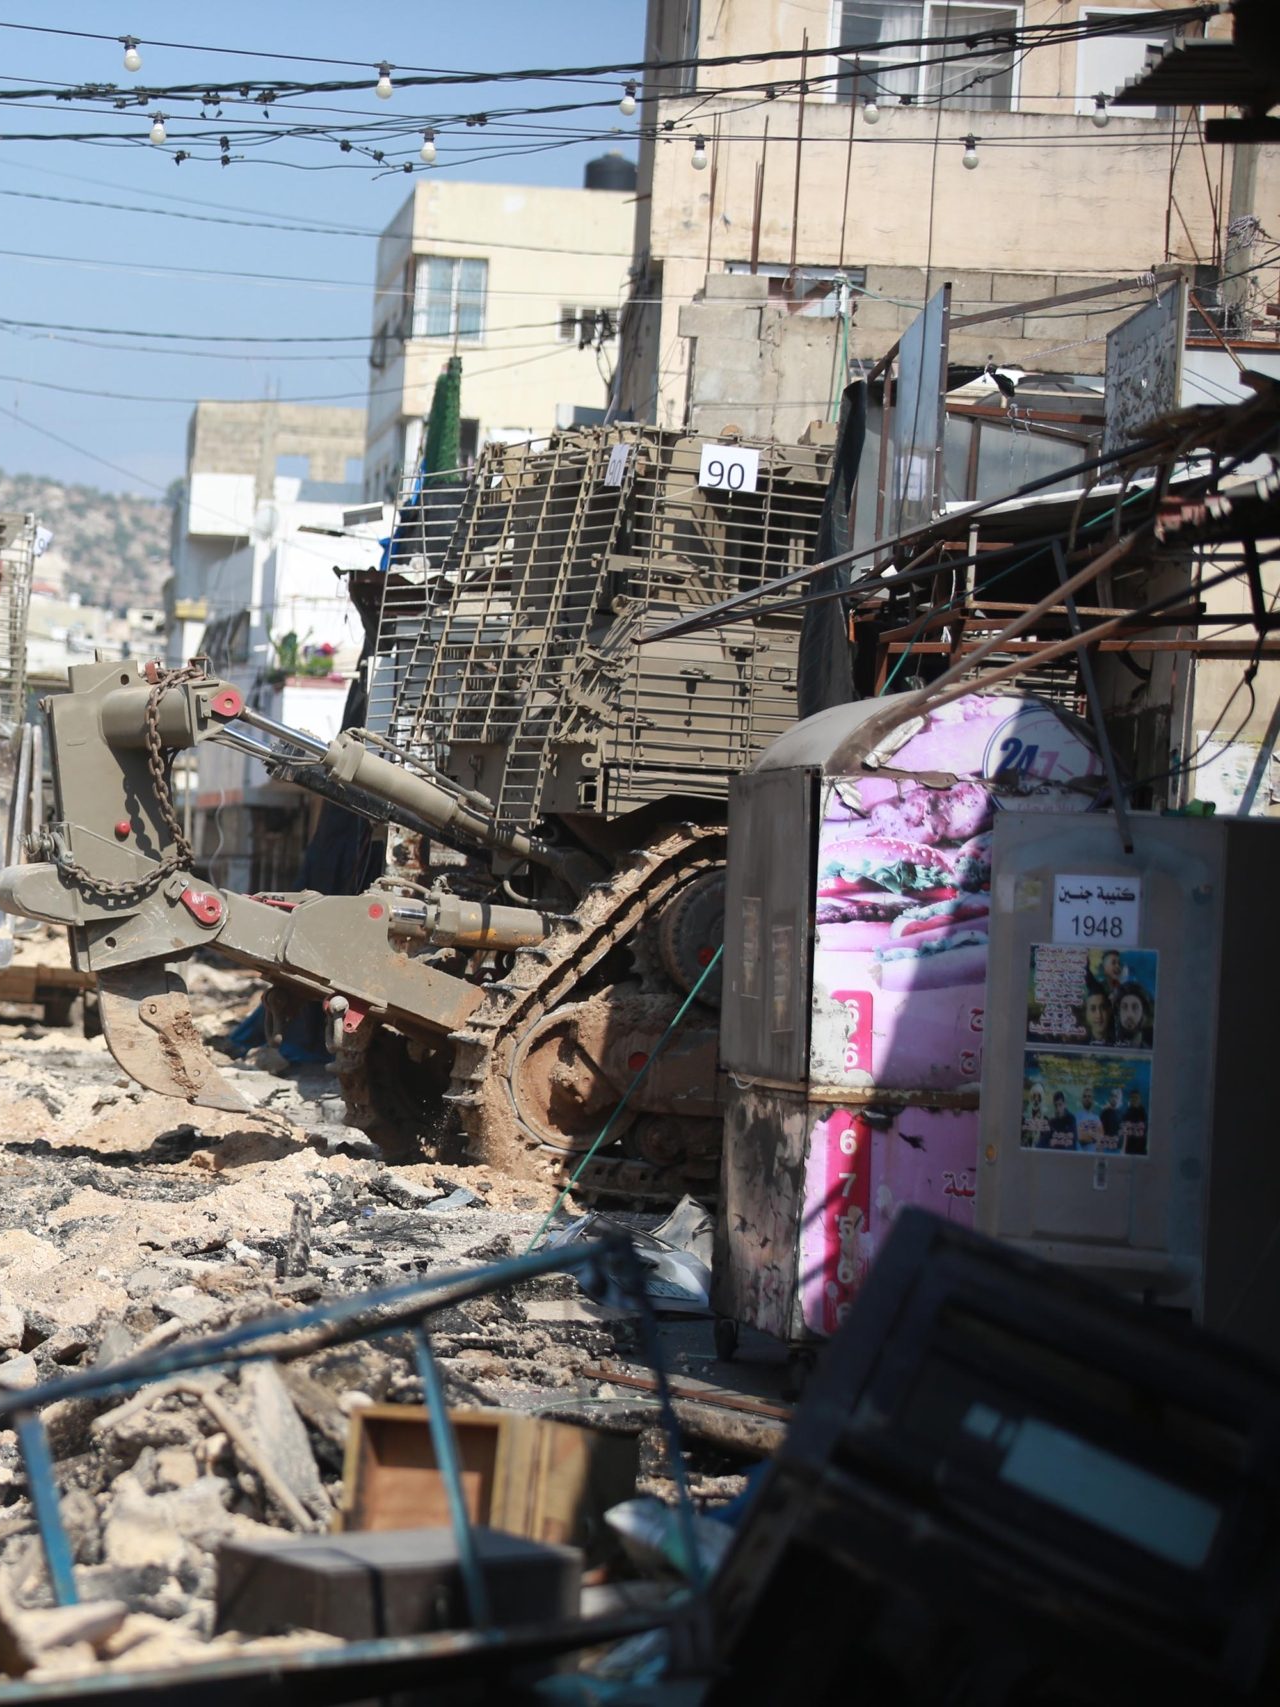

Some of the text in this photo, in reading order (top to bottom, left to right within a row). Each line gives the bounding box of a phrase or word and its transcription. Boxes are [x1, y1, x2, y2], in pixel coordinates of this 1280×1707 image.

[707, 460, 745, 490] 90
[1058, 885, 1136, 905] كتيبة جنين
[1071, 914, 1123, 938] 1948
[839, 1128, 857, 1155] 6
[838, 1172, 857, 1198] 7
[836, 1255, 855, 1284] 6
